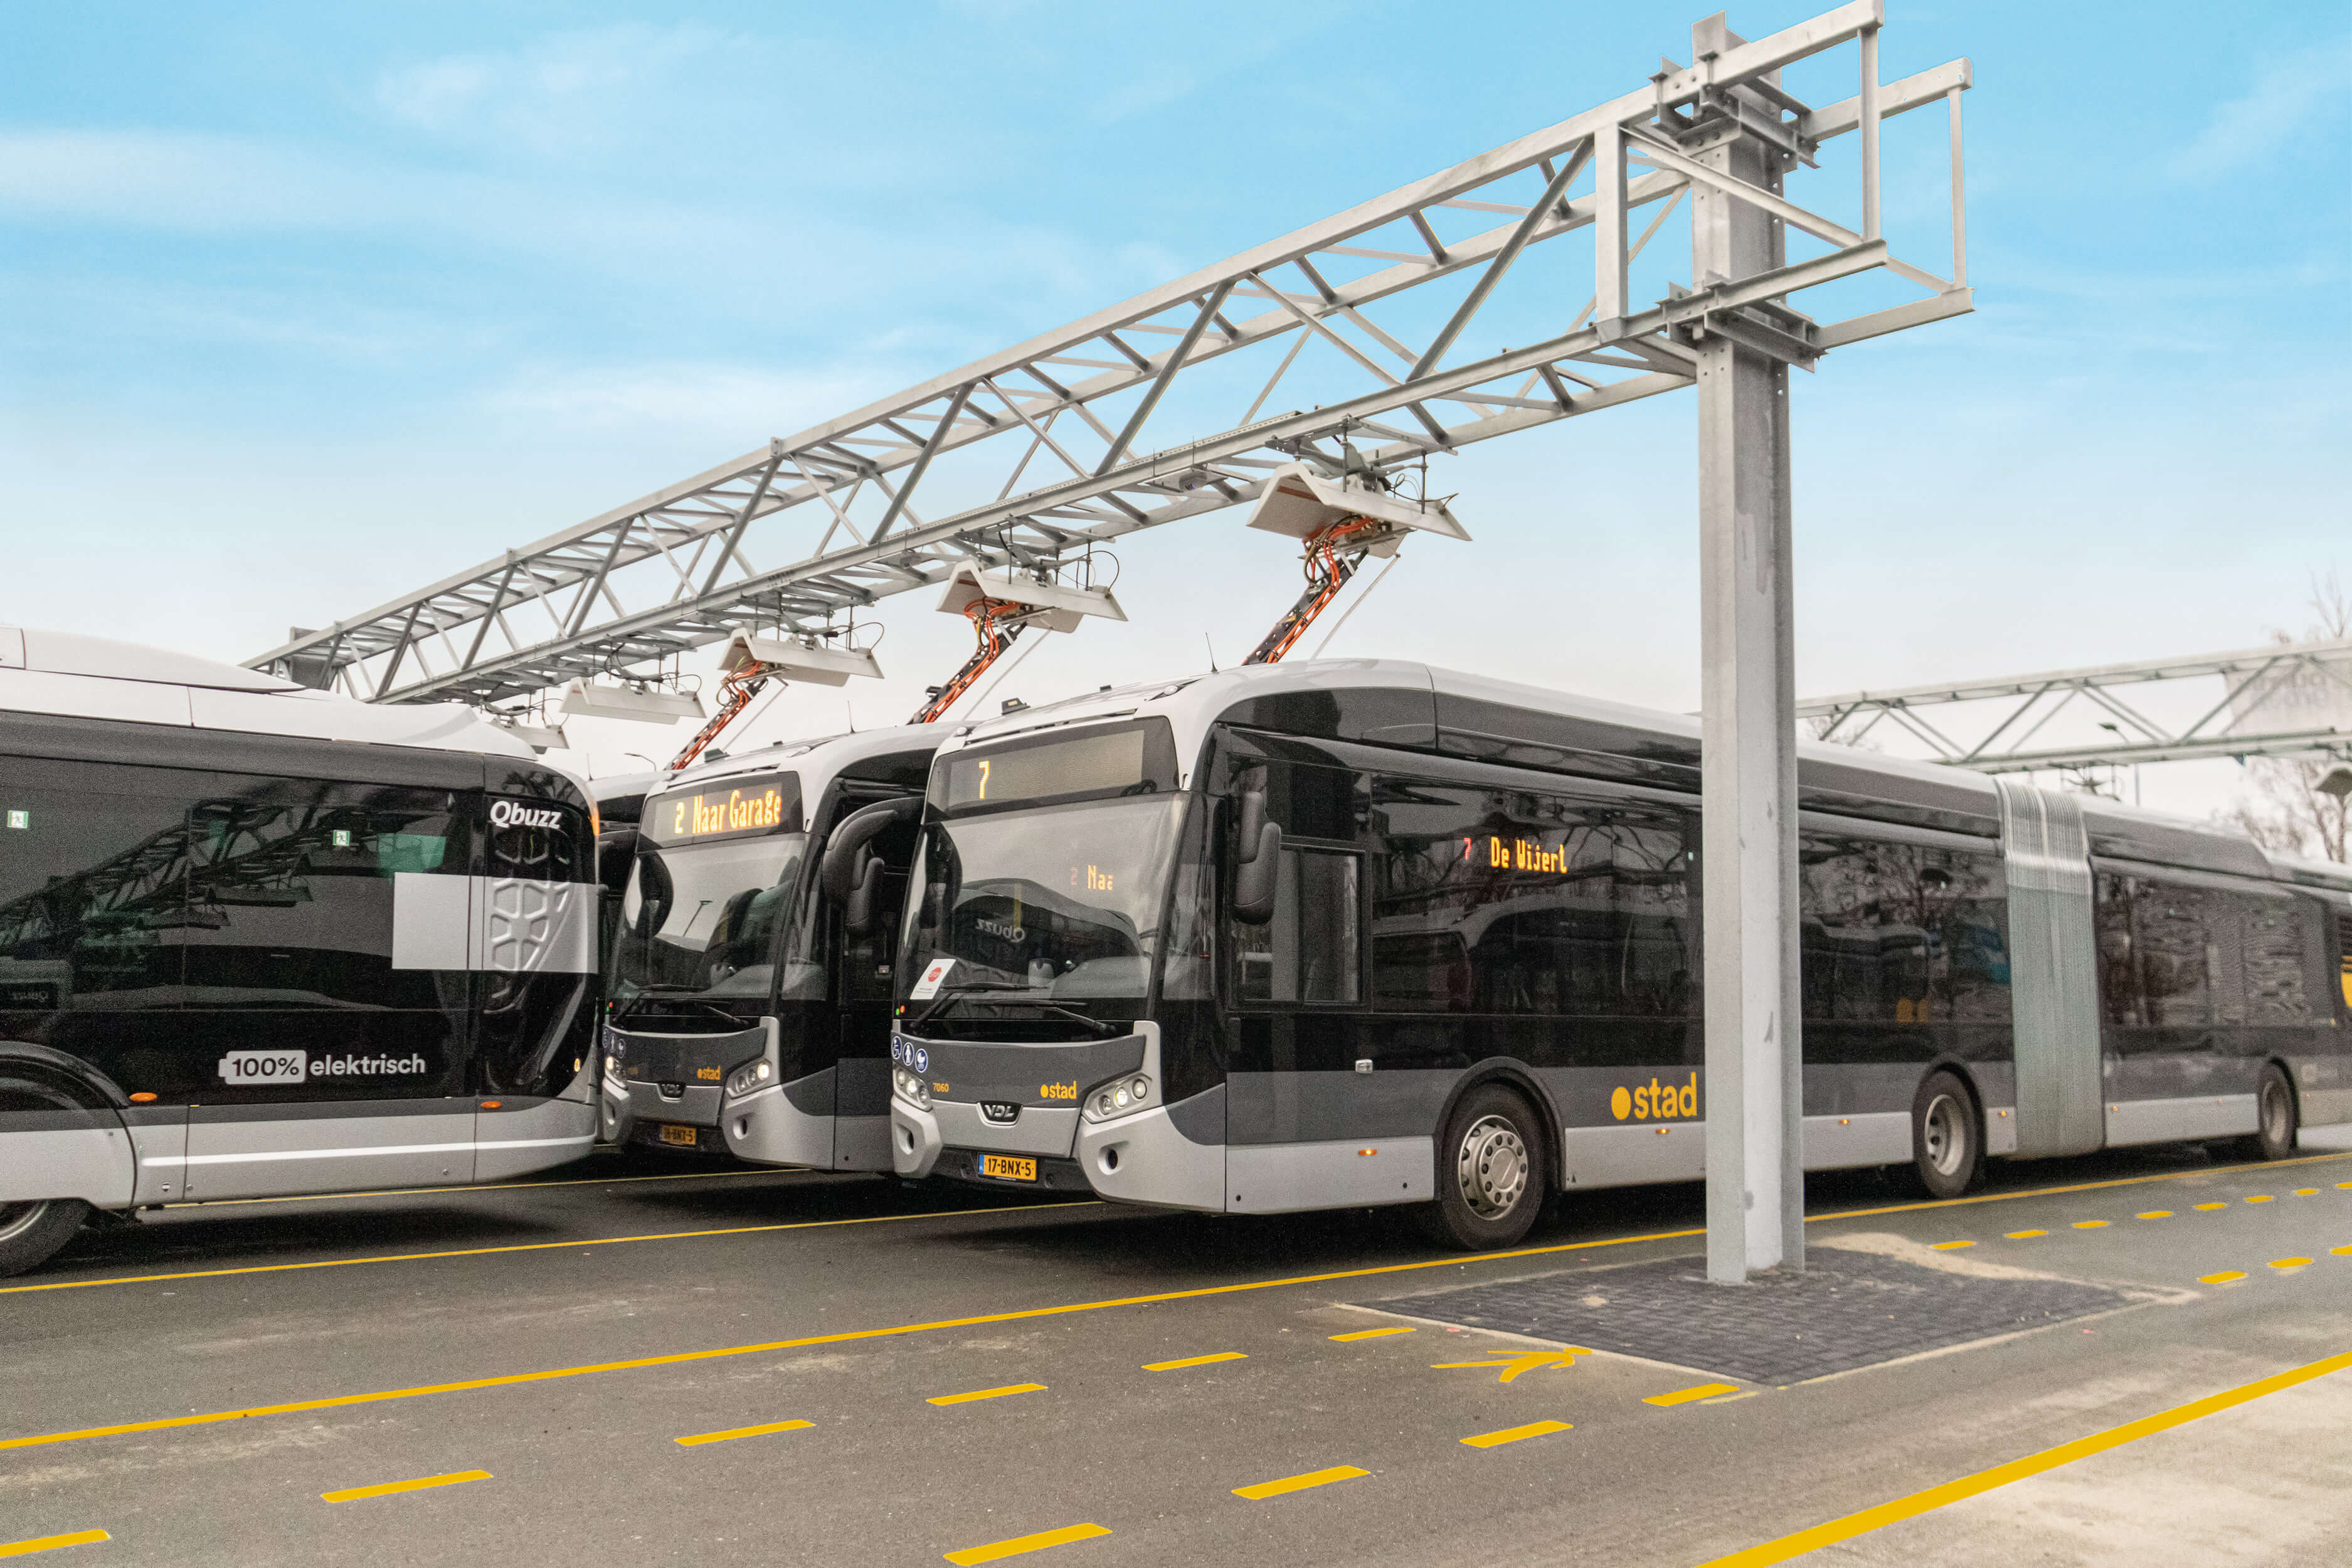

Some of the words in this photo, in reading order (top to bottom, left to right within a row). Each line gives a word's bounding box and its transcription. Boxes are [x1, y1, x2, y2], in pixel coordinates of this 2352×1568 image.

[978, 760, 990, 800] 7
[490, 800, 562, 829] Qbuzz
[674, 802, 685, 834] 2
[692, 795, 726, 834] Naar
[729, 788, 782, 829] Garage
[1463, 837, 1471, 861] 7
[1490, 836, 1510, 869] De
[1515, 839, 1568, 874] Wijert
[231, 1057, 300, 1077] 100%
[310, 1053, 426, 1076] elektrisch
[702, 1065, 721, 1081] stad
[1049, 1080, 1077, 1099] stad
[1633, 1071, 1698, 1120] stad
[984, 1104, 1015, 1118] VDL
[987, 1158, 1032, 1177] 17-BNX-5
